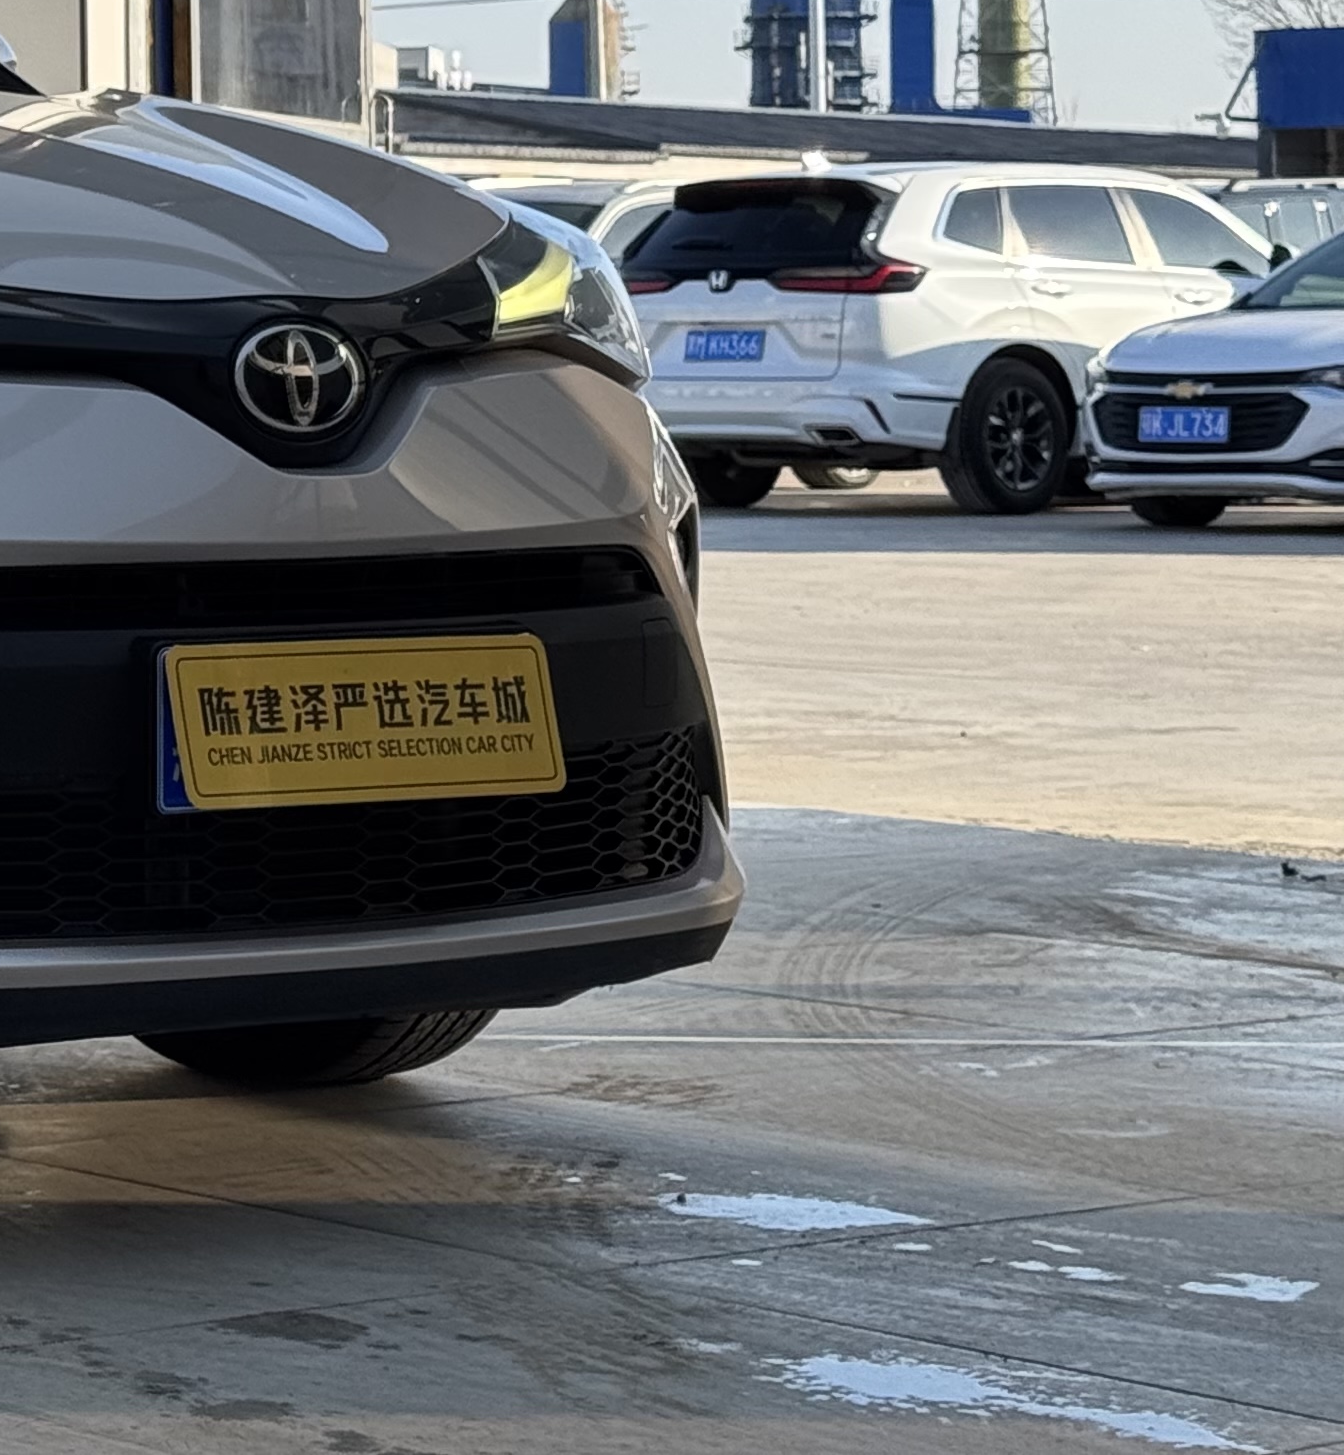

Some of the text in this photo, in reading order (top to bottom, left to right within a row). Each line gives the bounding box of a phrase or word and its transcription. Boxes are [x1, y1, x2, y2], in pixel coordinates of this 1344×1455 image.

[197, 675, 531, 737] 陈建泽严选汽车城
[207, 747, 253, 767] CHEN
[257, 743, 313, 764] JIANZE
[317, 740, 372, 760] STRICT
[377, 737, 463, 758] SELECTION
[465, 734, 499, 754] CAR
[500, 733, 535, 752] CITY
